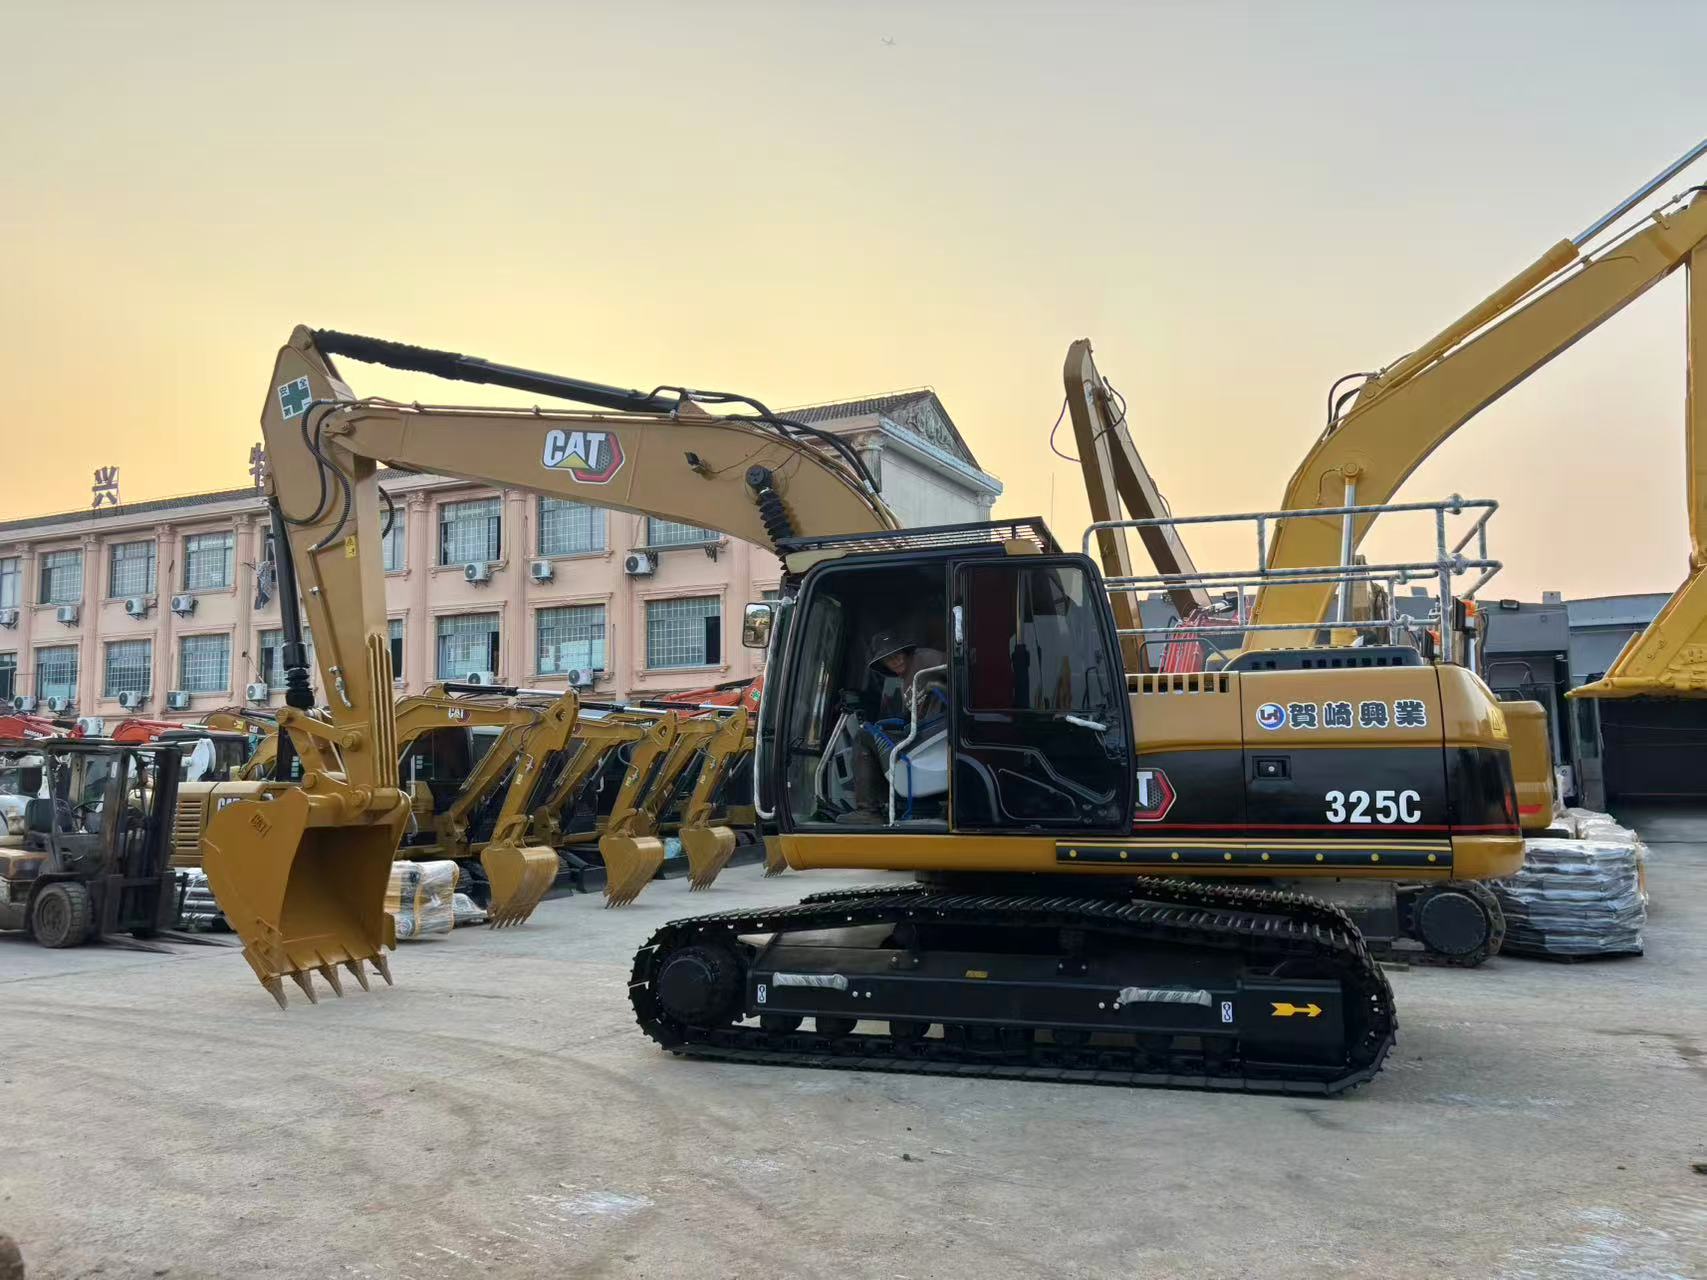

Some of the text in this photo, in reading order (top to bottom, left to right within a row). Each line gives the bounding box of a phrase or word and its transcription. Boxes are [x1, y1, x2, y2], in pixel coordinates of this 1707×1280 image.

[543, 429, 606, 469] CAT
[92, 466, 118, 508] 兴
[1325, 790, 1421, 823] 325C
